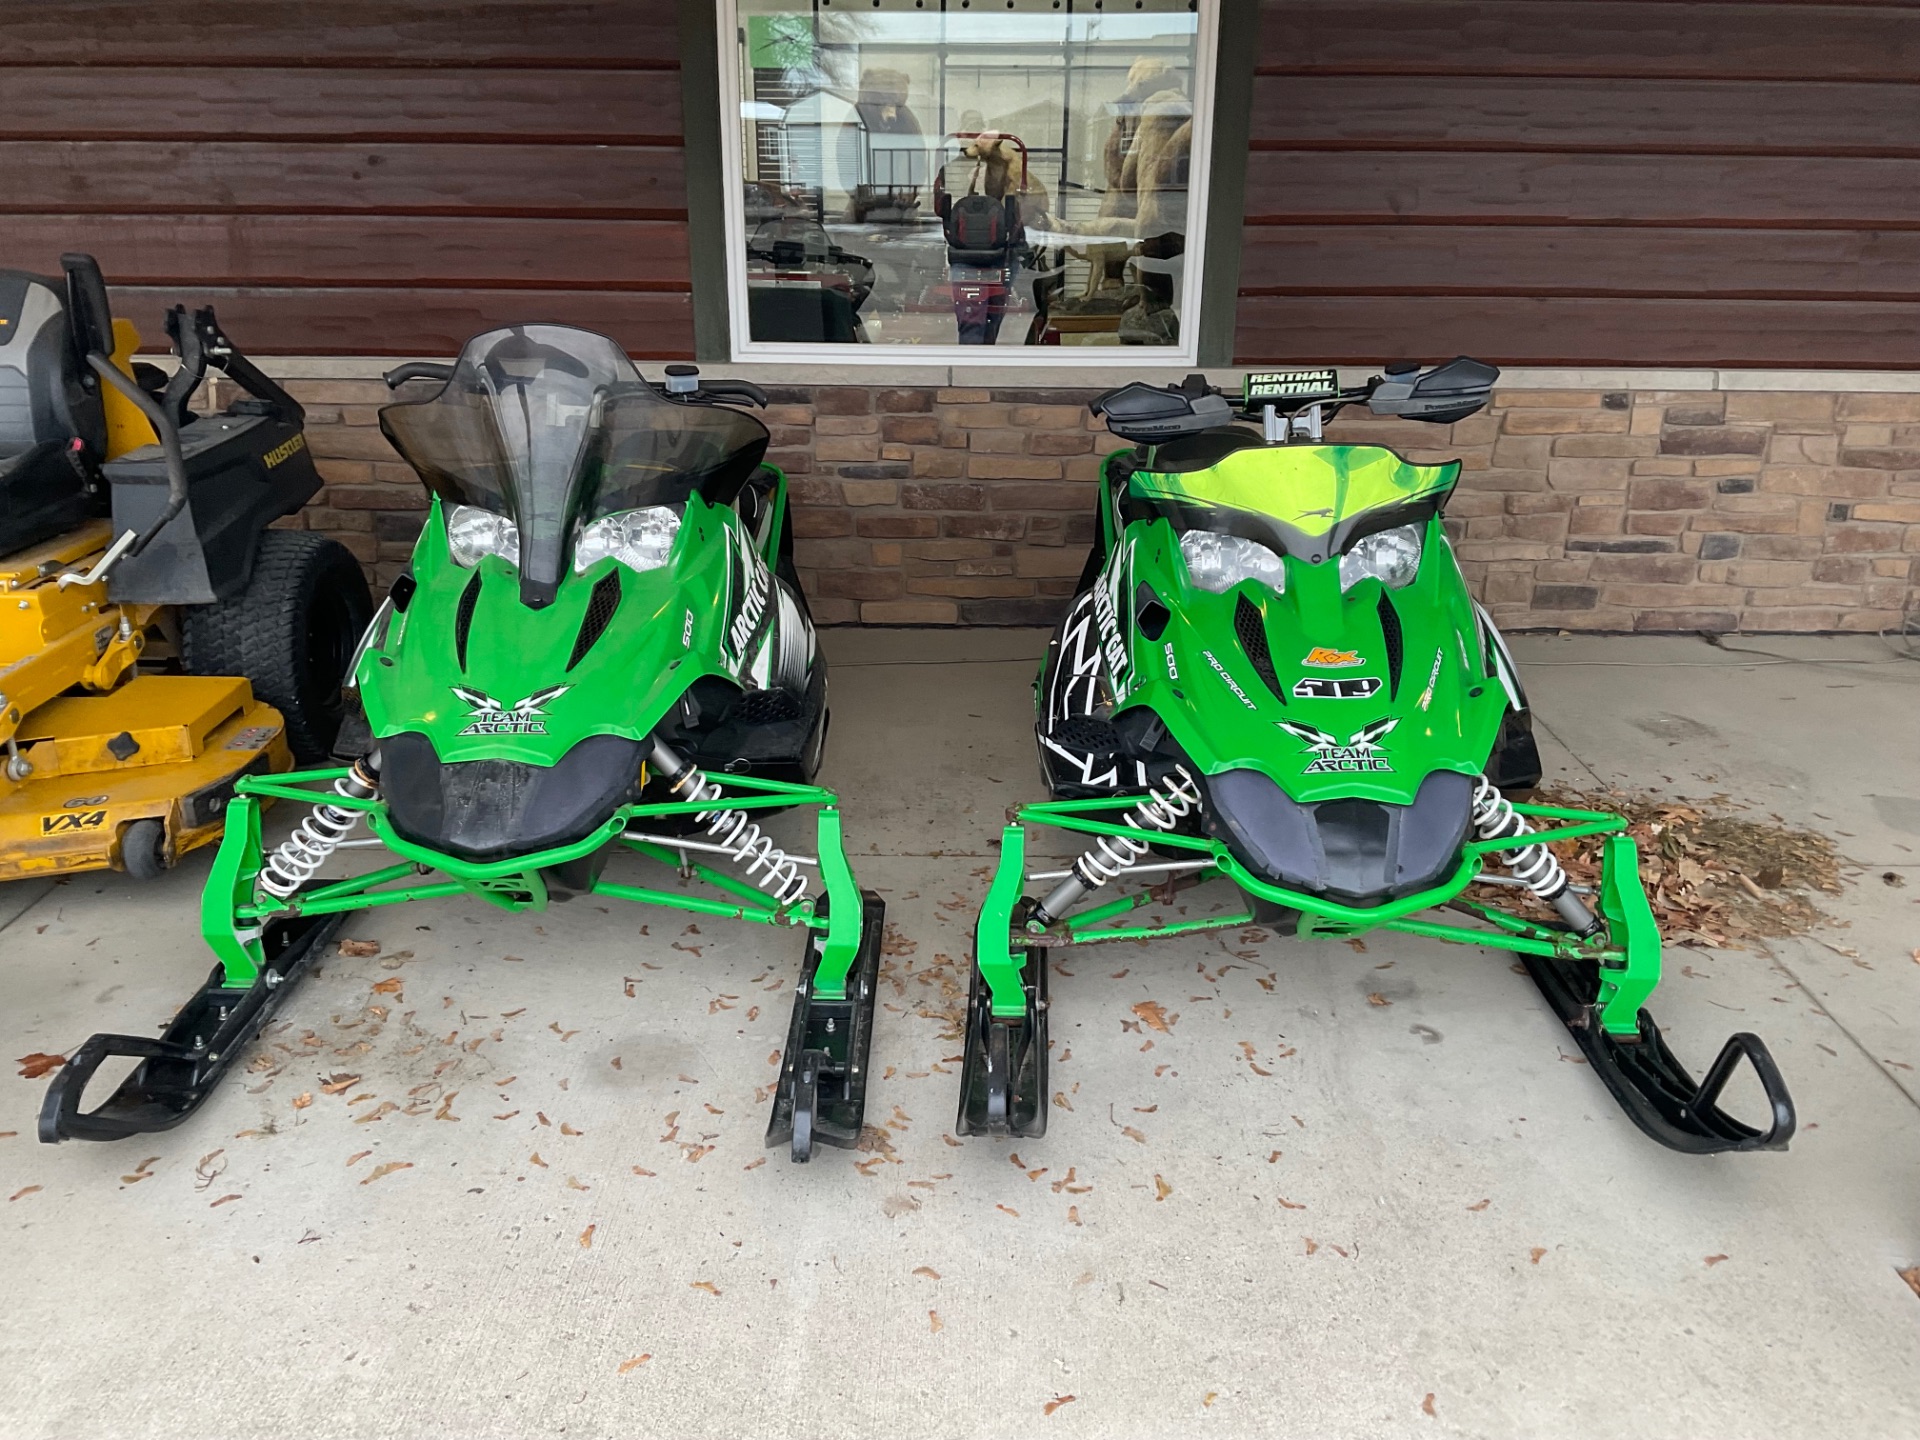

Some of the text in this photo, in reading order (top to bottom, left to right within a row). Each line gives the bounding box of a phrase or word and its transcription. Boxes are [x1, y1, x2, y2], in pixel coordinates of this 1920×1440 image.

[1250, 371, 1333, 383] RENTHAL
[1250, 381, 1334, 395] RENTHAL
[263, 433, 305, 469] HUSTLER
[682, 608, 694, 649] 500
[731, 579, 766, 658] ARCTIC
[1094, 572, 1129, 679] ARCTIC CAT
[1164, 642, 1178, 680] 500
[1203, 650, 1257, 710] PRO CIRCUIT
[480, 711, 531, 722] TEAM
[462, 722, 544, 733] ARCTIC
[1318, 747, 1371, 759] TEAM
[1306, 759, 1390, 771] ARCTIC
[42, 810, 107, 831] VX4
